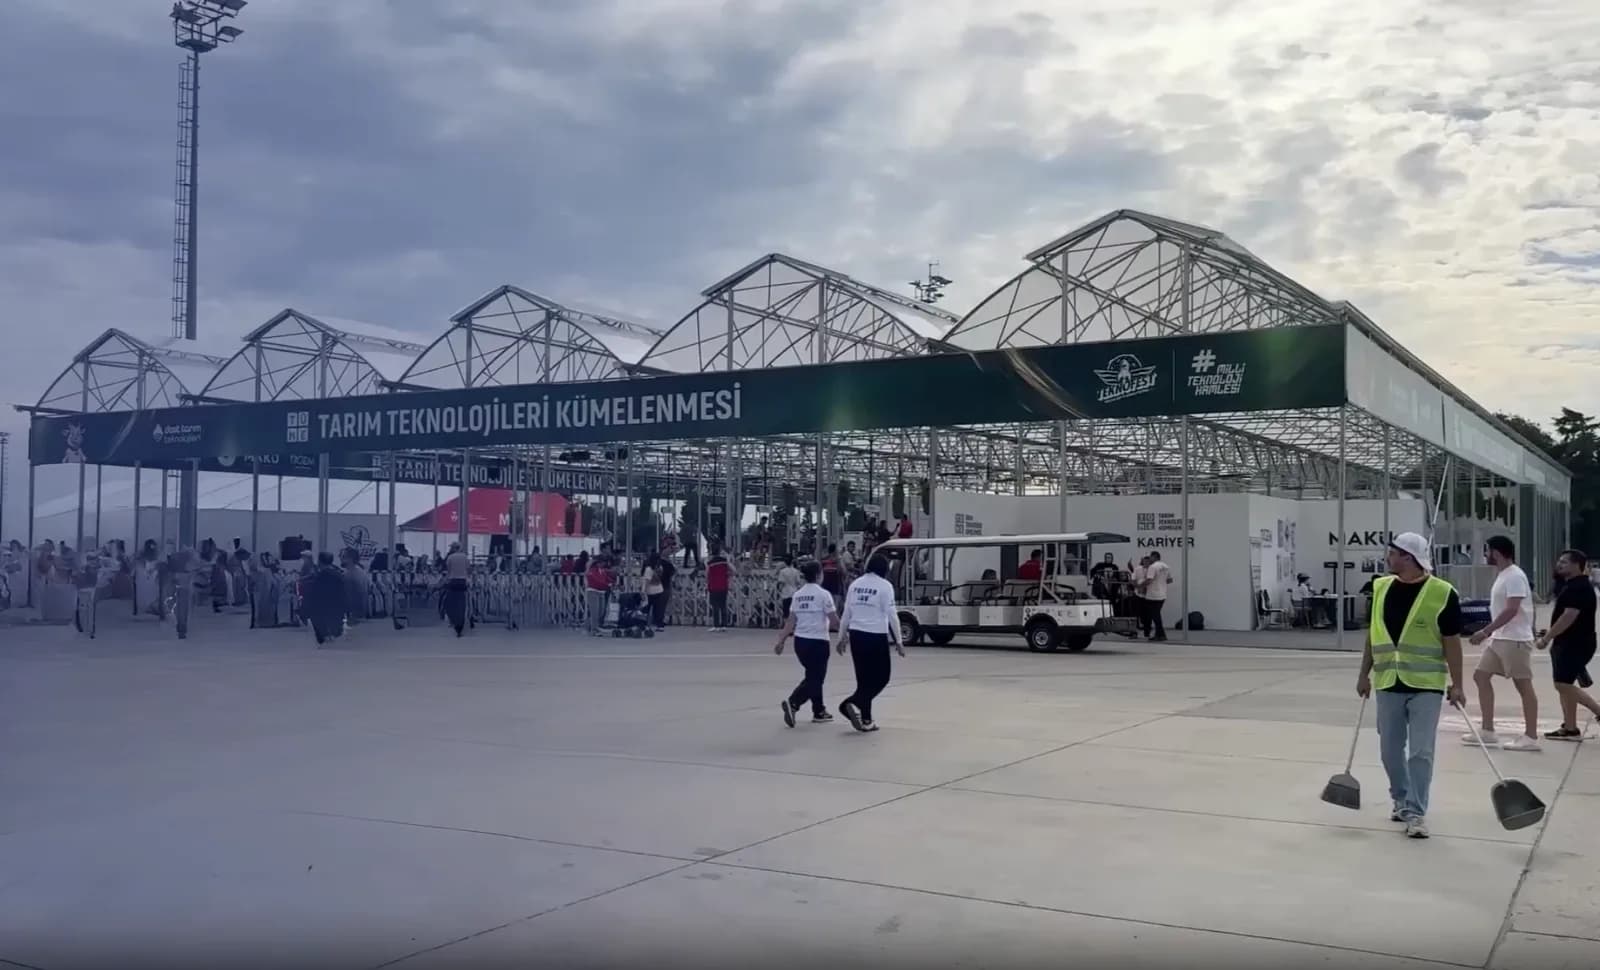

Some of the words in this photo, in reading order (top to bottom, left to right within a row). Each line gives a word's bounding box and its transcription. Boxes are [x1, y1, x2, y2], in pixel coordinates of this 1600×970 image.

[318, 410, 382, 438] TARIM
[386, 395, 549, 437] TEKNOLOJİLERİ
[556, 382, 741, 428] KÜMELENMESİ
[1137, 535, 1195, 548] KARİYER
